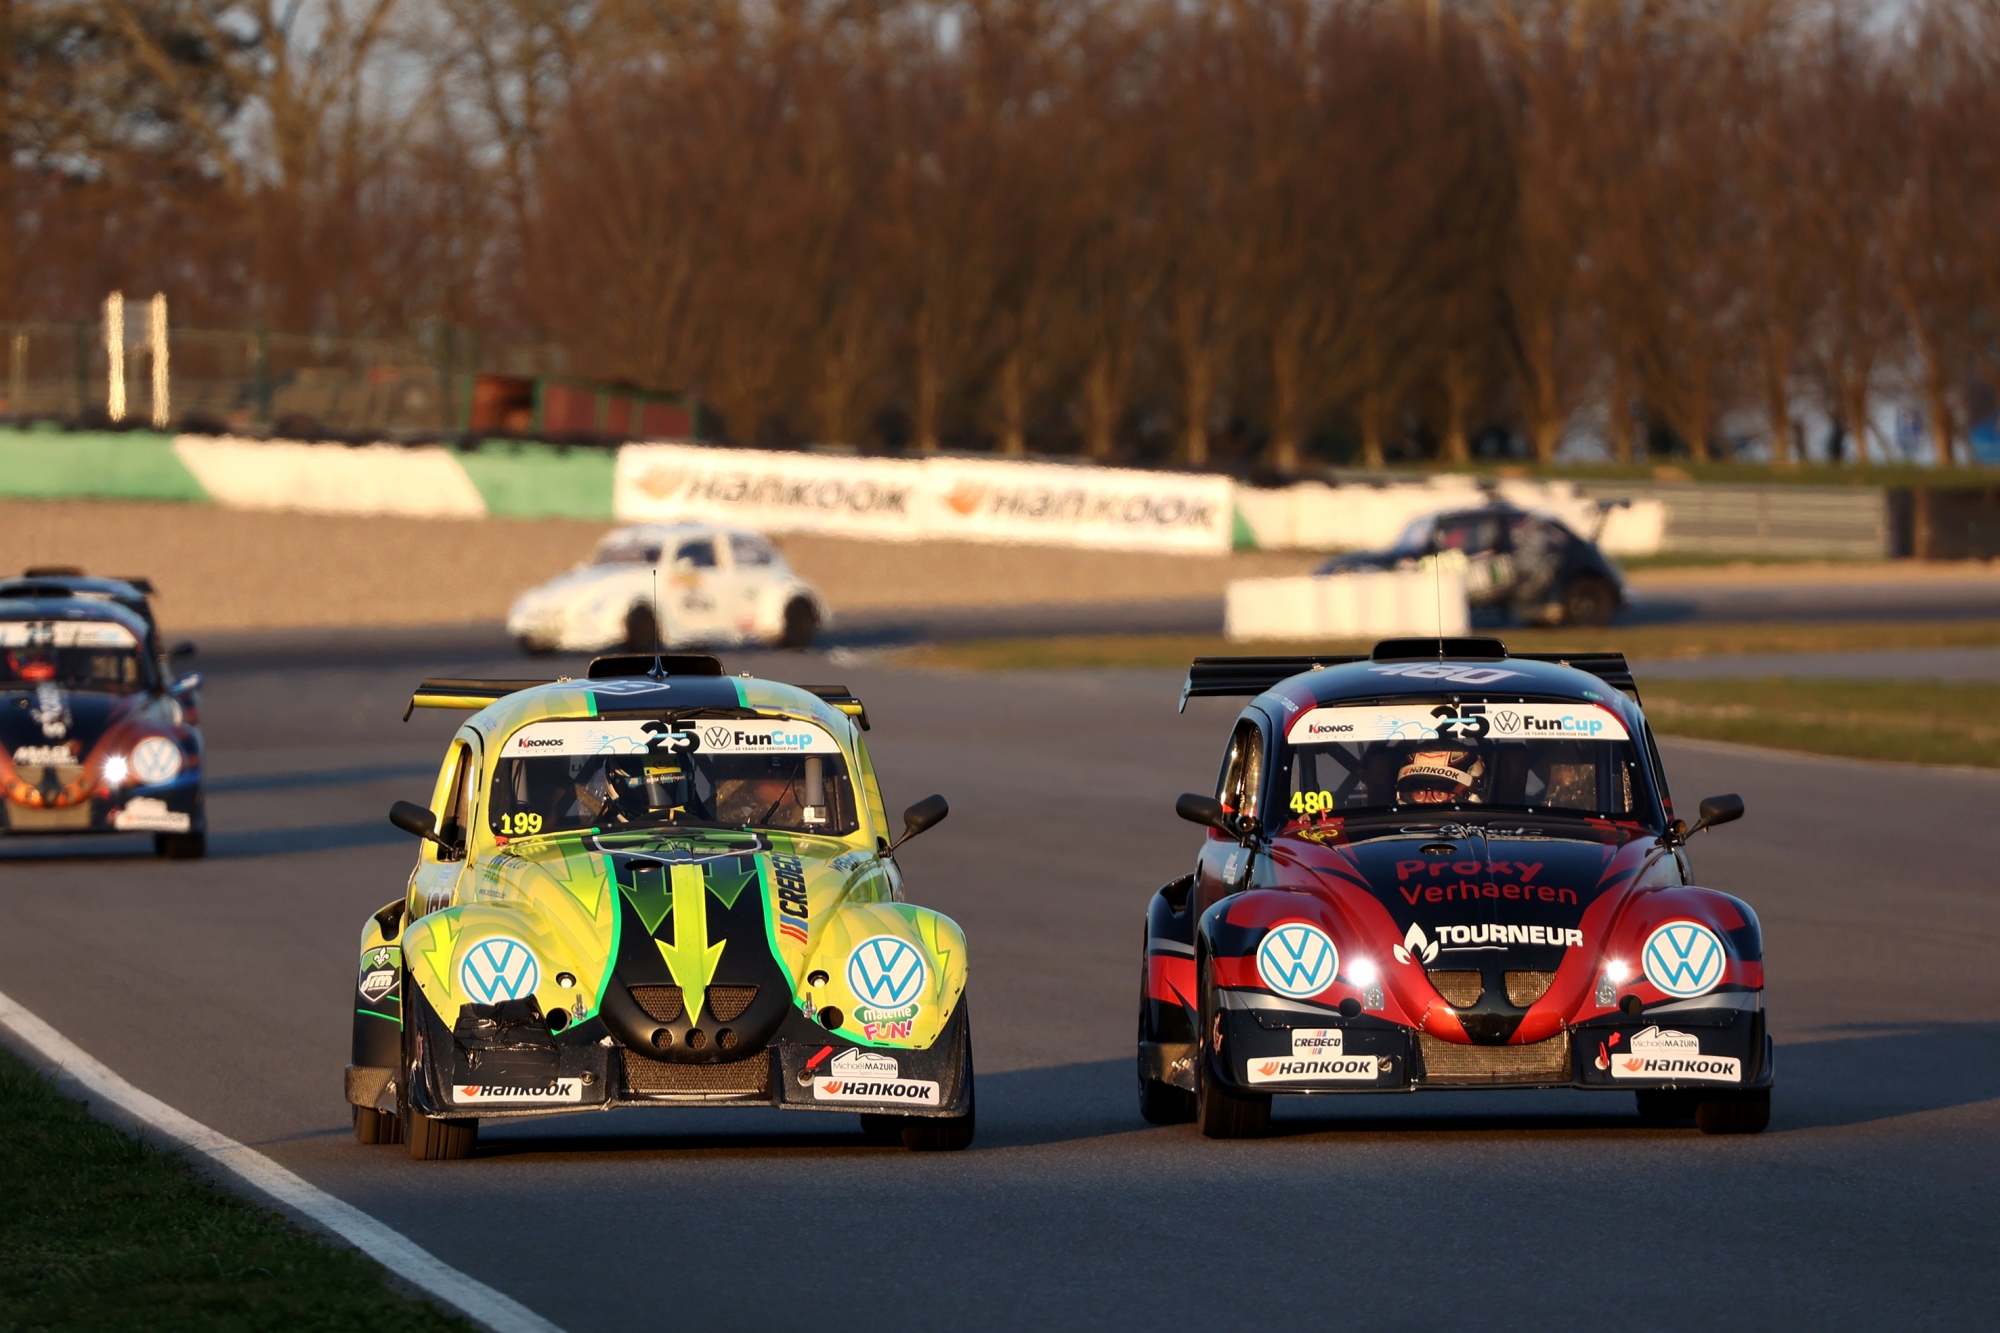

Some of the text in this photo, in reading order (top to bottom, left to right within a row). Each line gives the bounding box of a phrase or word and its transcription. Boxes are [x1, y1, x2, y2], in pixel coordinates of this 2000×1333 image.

[1309, 722, 1353, 734] KRONOS
[1430, 705, 1490, 738] 25
[1524, 716, 1602, 736] FunCup
[518, 736, 563, 748] KRONOS
[640, 720, 700, 754] 25
[734, 730, 812, 750] FunCup
[1290, 791, 1334, 814] 480
[501, 812, 543, 834] 199
[1395, 860, 1544, 882] Proxy
[1399, 880, 1578, 905] Verhaeren
[1435, 923, 1584, 947] TOURNEUR
[863, 1020, 913, 1041] FUN!
[1294, 1038, 1341, 1047] CREDECO
